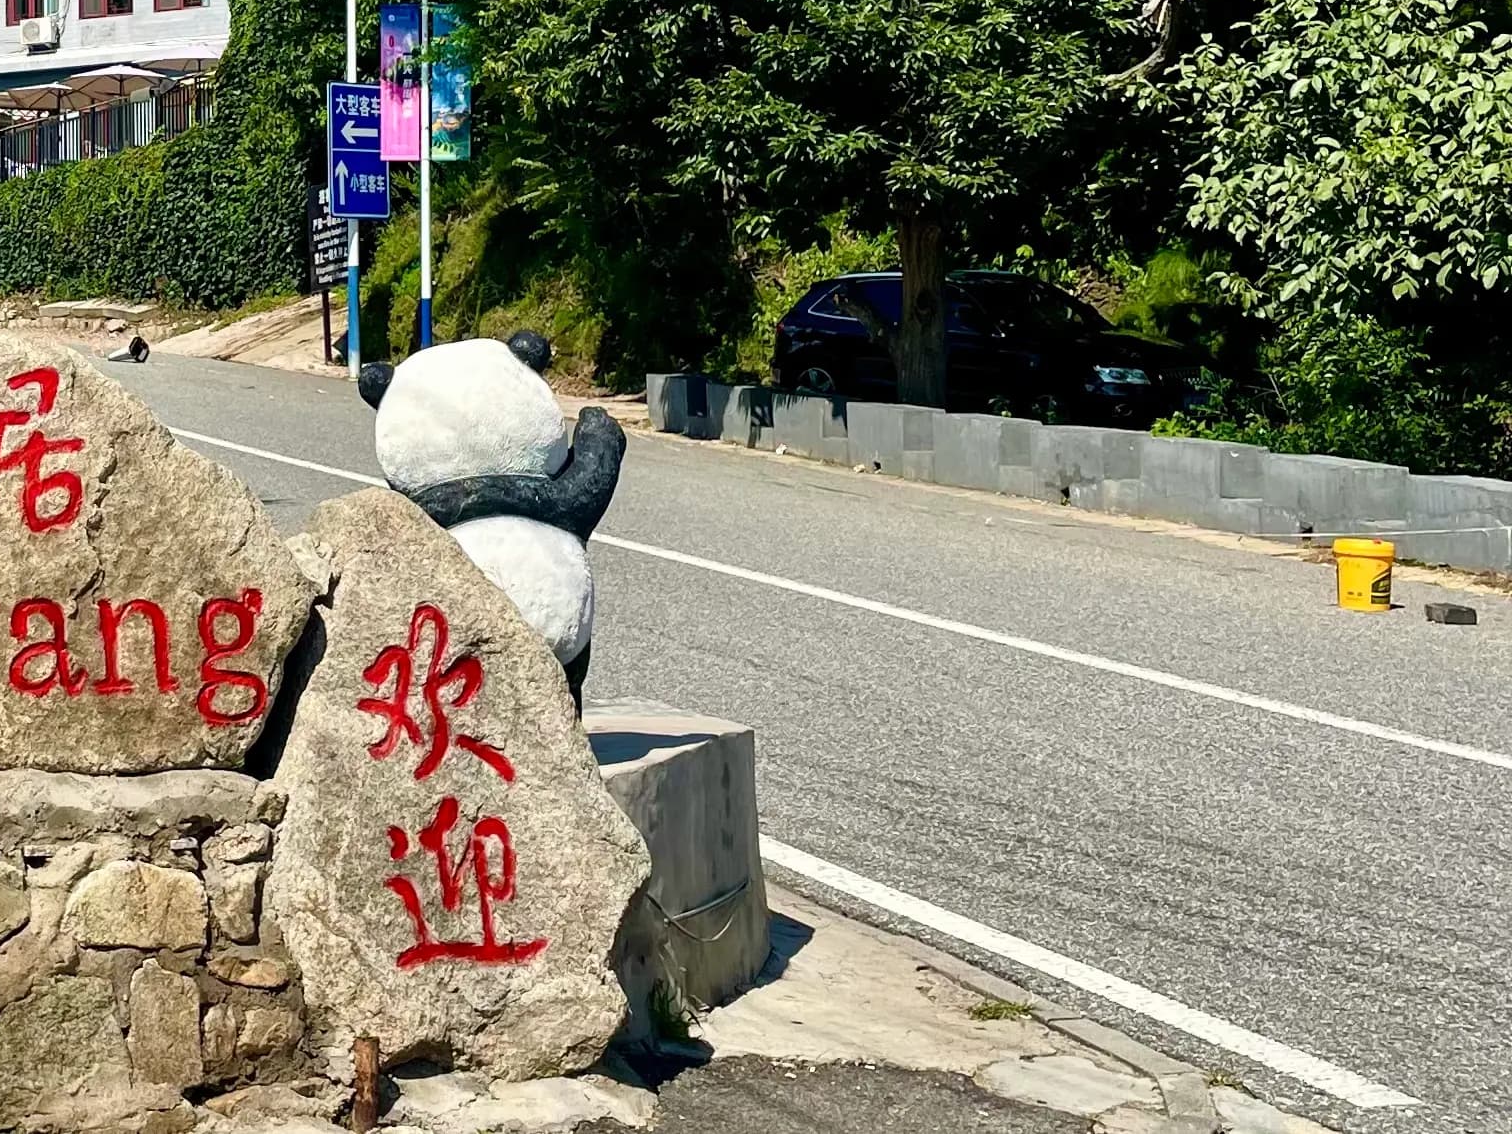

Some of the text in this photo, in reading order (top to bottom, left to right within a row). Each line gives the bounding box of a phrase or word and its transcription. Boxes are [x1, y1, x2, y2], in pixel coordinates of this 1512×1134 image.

[335, 93, 381, 117] 大型客车
[350, 173, 385, 194] 小型客车
[357, 602, 549, 969] 欢迎
